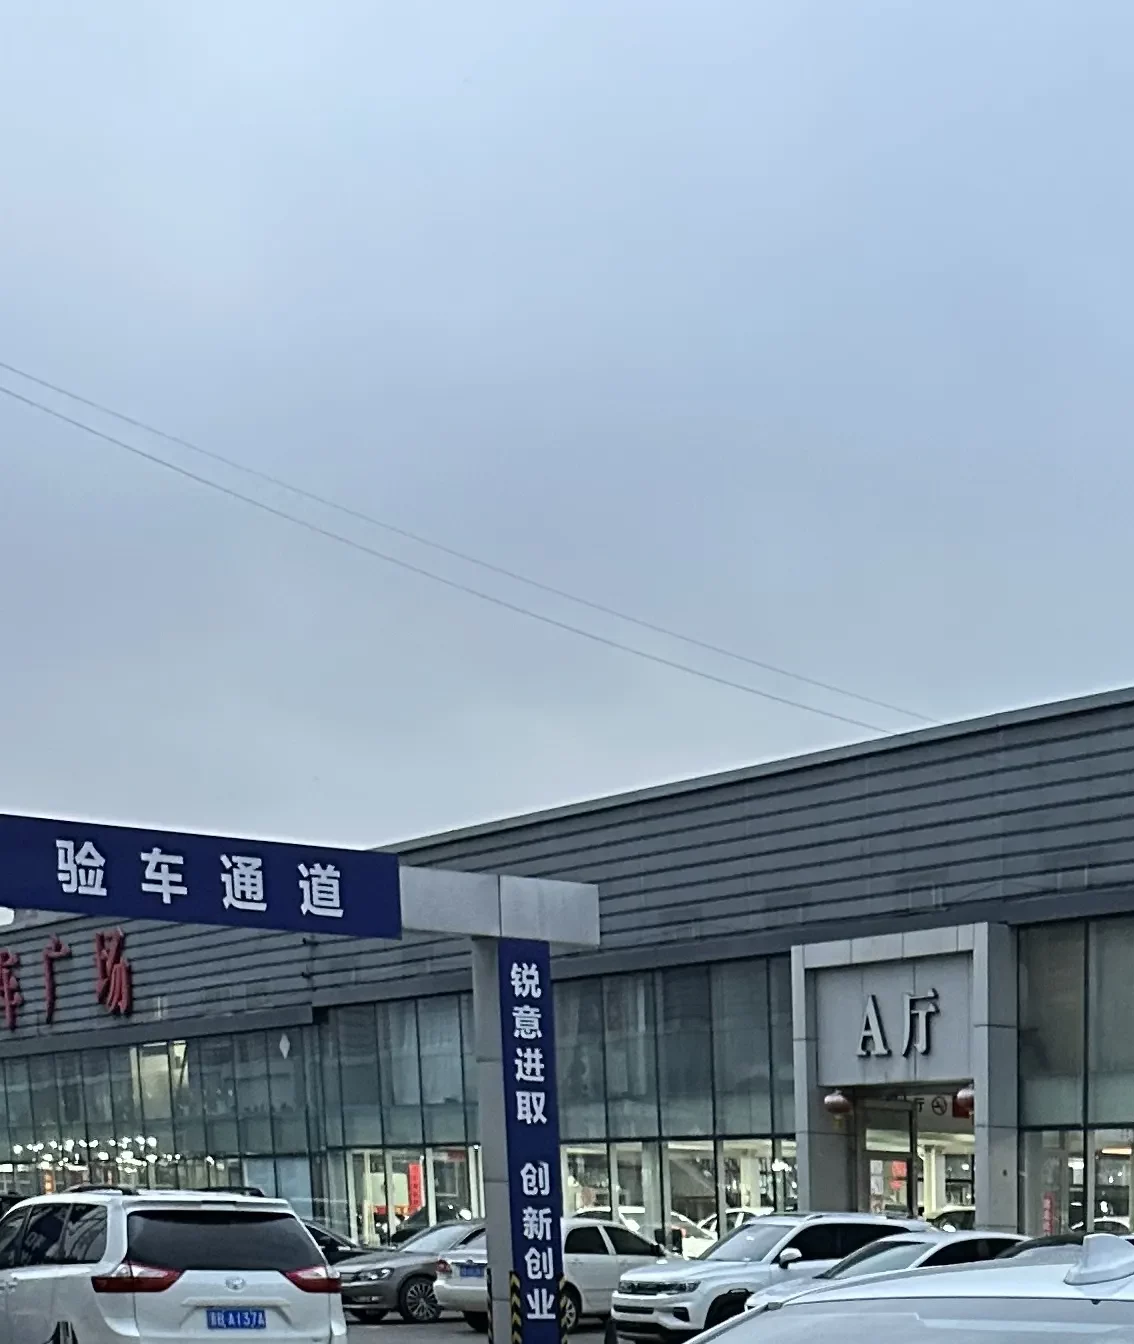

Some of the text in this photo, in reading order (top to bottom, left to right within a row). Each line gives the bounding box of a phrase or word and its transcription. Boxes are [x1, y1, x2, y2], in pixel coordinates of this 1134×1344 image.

[56, 838, 345, 918] 验车通道
[856, 987, 940, 1057] A厅
[510, 962, 556, 1321] 锐意进取 创新创业
